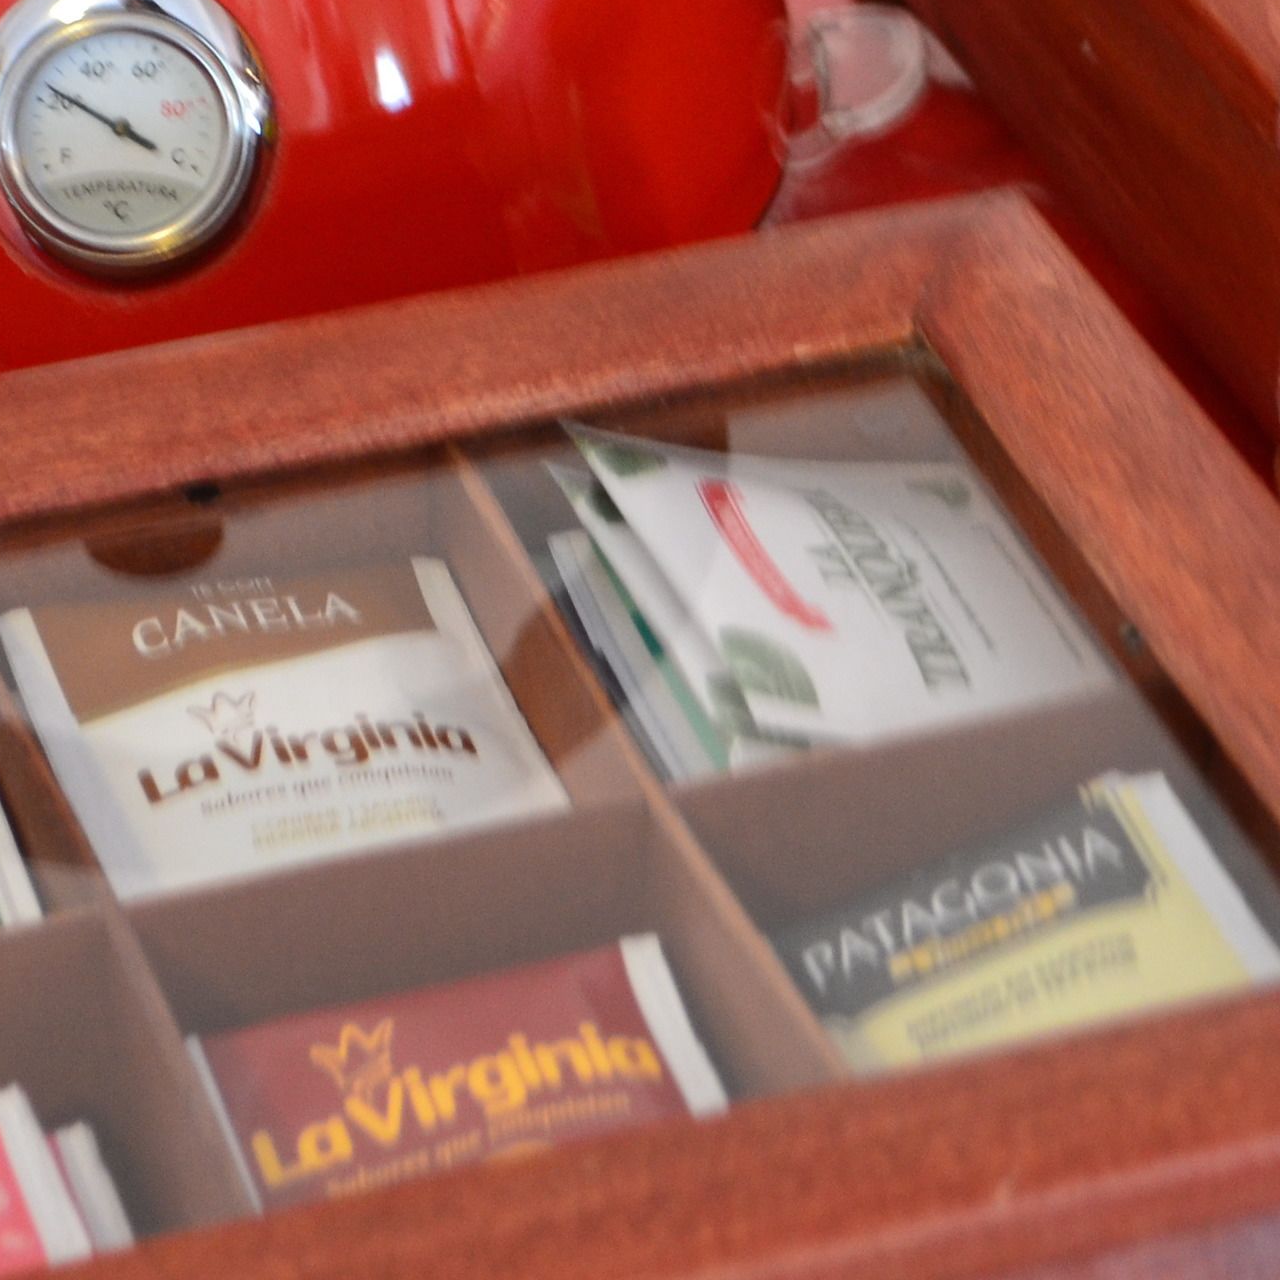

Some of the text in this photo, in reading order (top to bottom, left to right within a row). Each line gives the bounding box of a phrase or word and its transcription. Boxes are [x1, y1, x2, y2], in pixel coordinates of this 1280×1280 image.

[62, 178, 179, 201] TEMPERATURA
[131, 590, 363, 658] CANELA
[802, 826, 1124, 998] PATAGONIA
